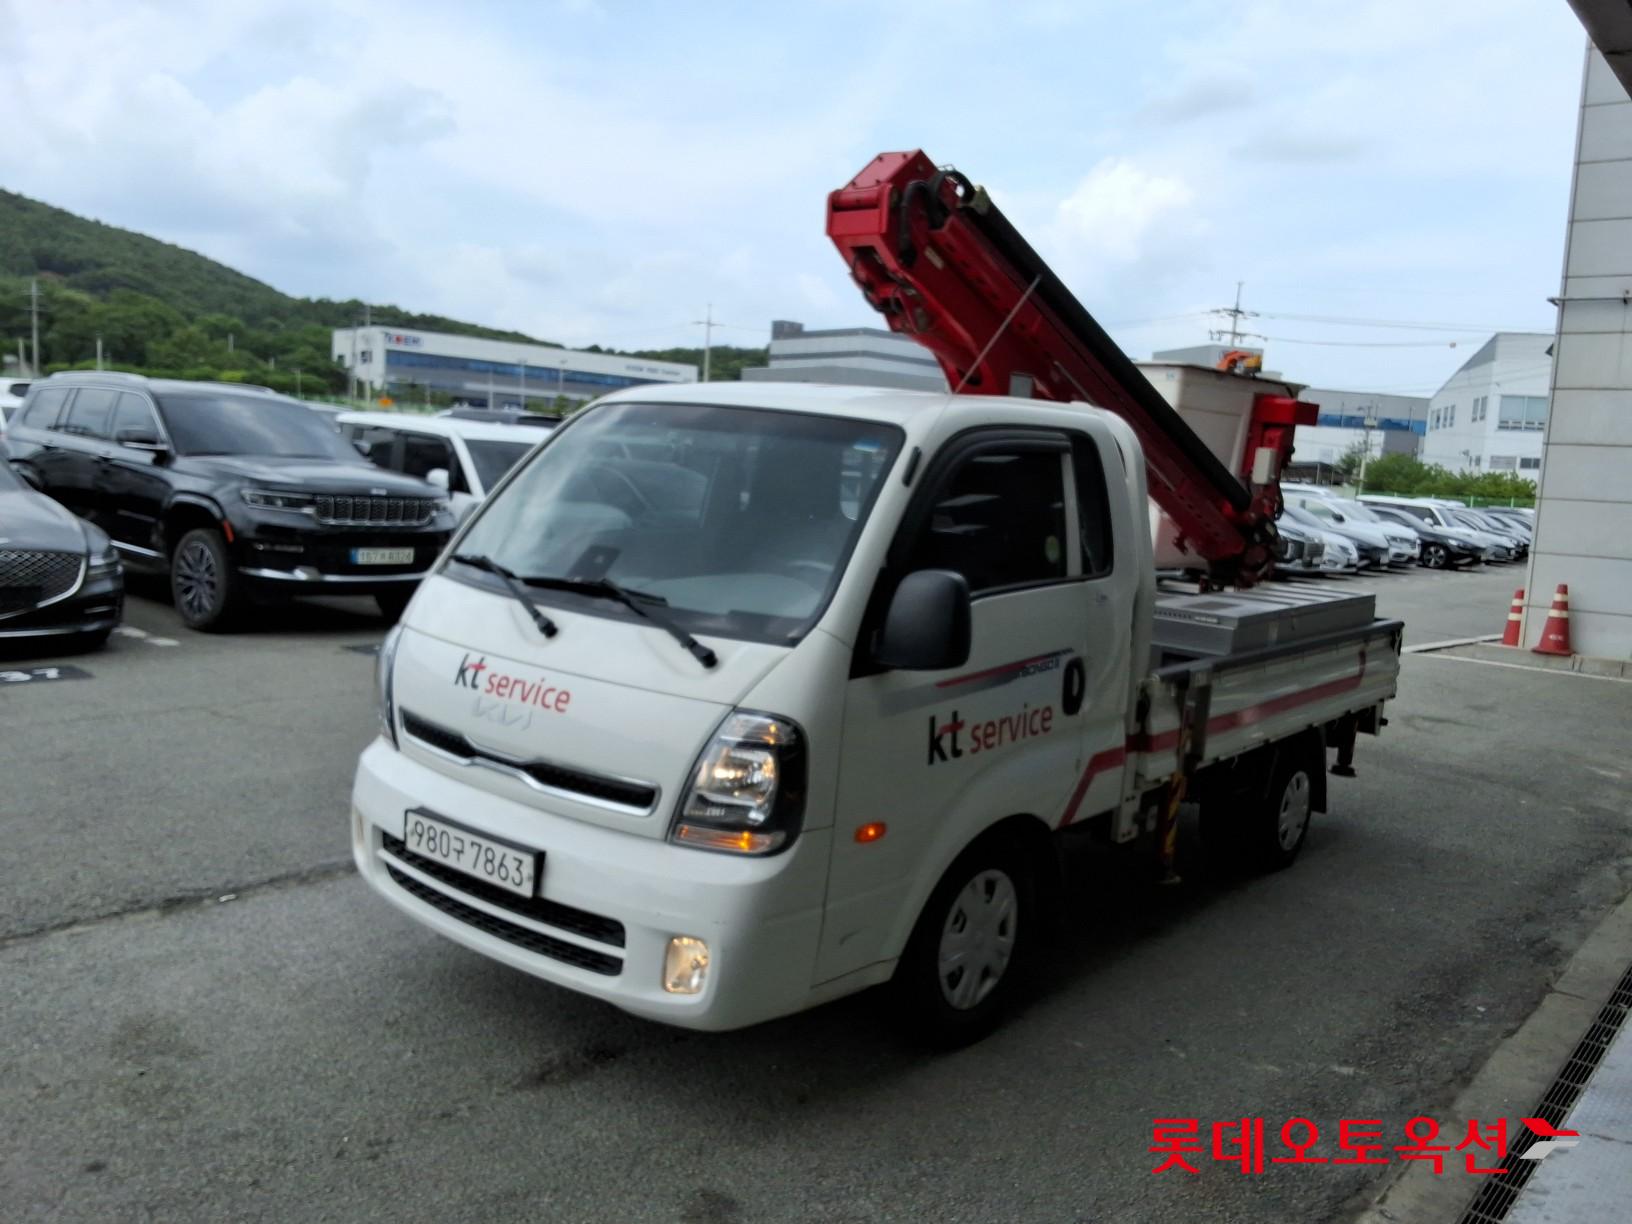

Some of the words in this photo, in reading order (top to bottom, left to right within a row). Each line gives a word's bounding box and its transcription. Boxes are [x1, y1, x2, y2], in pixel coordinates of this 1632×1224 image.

[454, 652, 487, 690] kt
[485, 672, 571, 714] service
[927, 709, 965, 766] kt
[969, 703, 1053, 755] service
